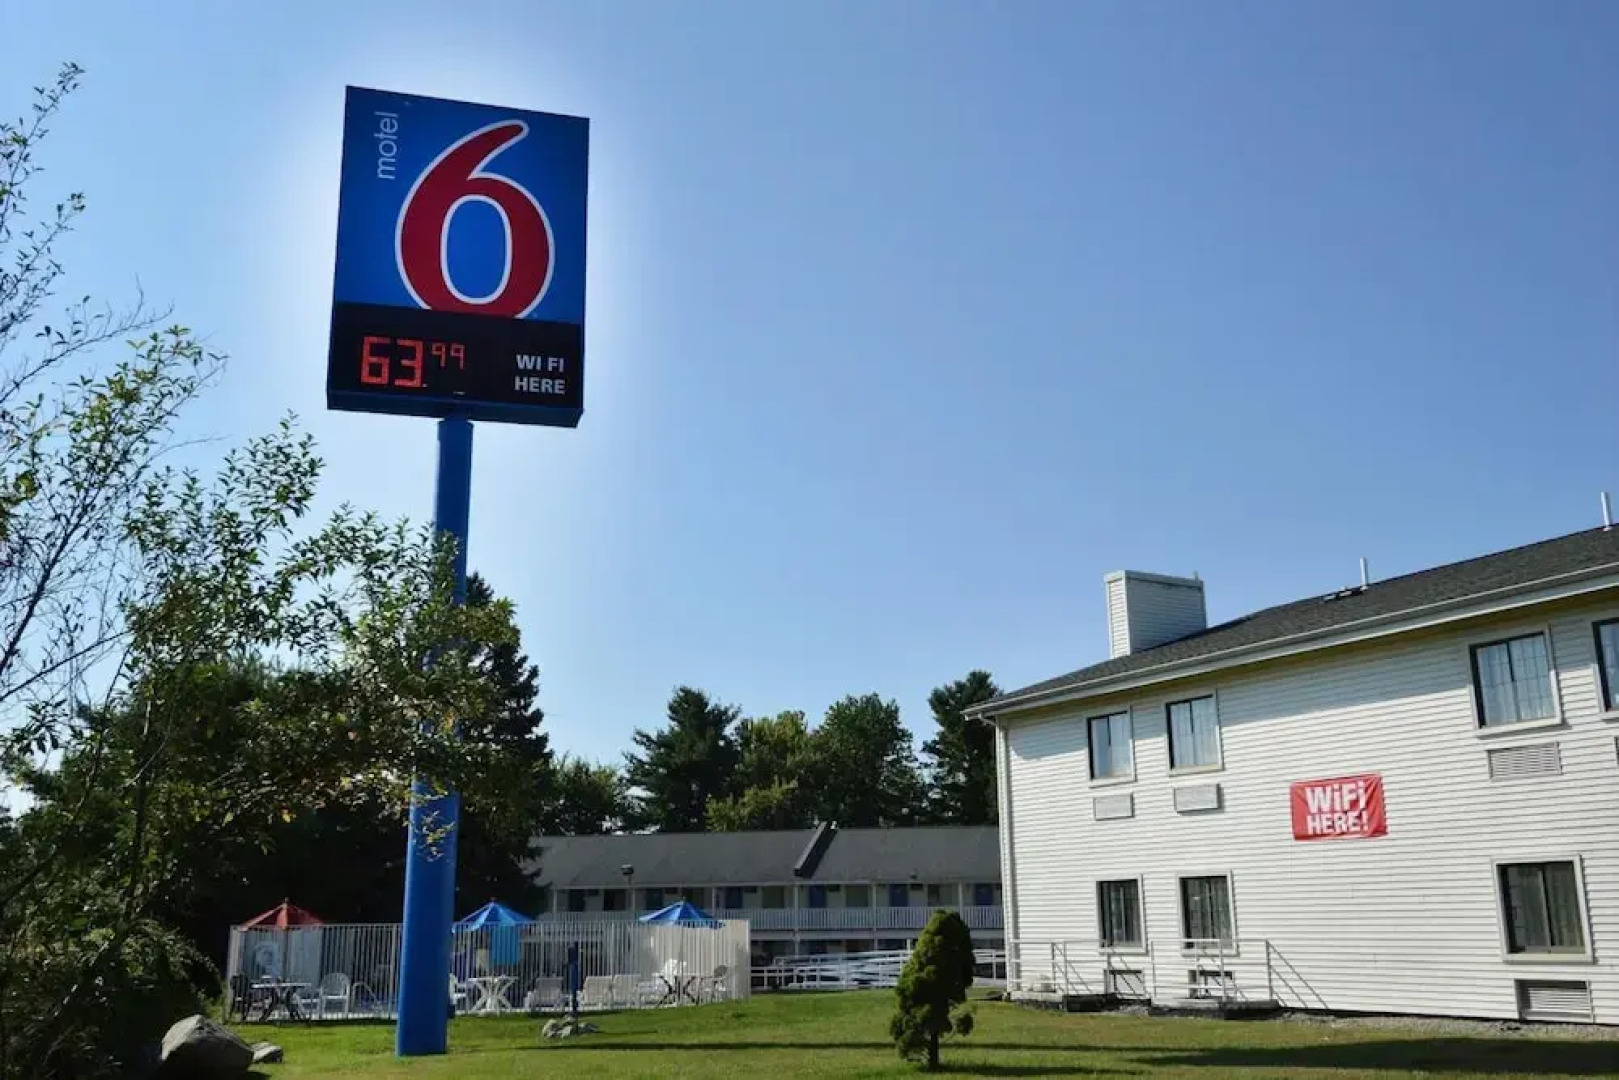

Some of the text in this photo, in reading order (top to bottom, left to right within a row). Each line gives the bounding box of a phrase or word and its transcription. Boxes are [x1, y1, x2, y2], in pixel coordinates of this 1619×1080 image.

[374, 111, 398, 180] motel
[394, 119, 555, 319] 6
[516, 354, 564, 372] WI FI
[514, 376, 566, 394] HERE
[1304, 780, 1367, 814] WiFi
[1306, 809, 1369, 835] HERE!
